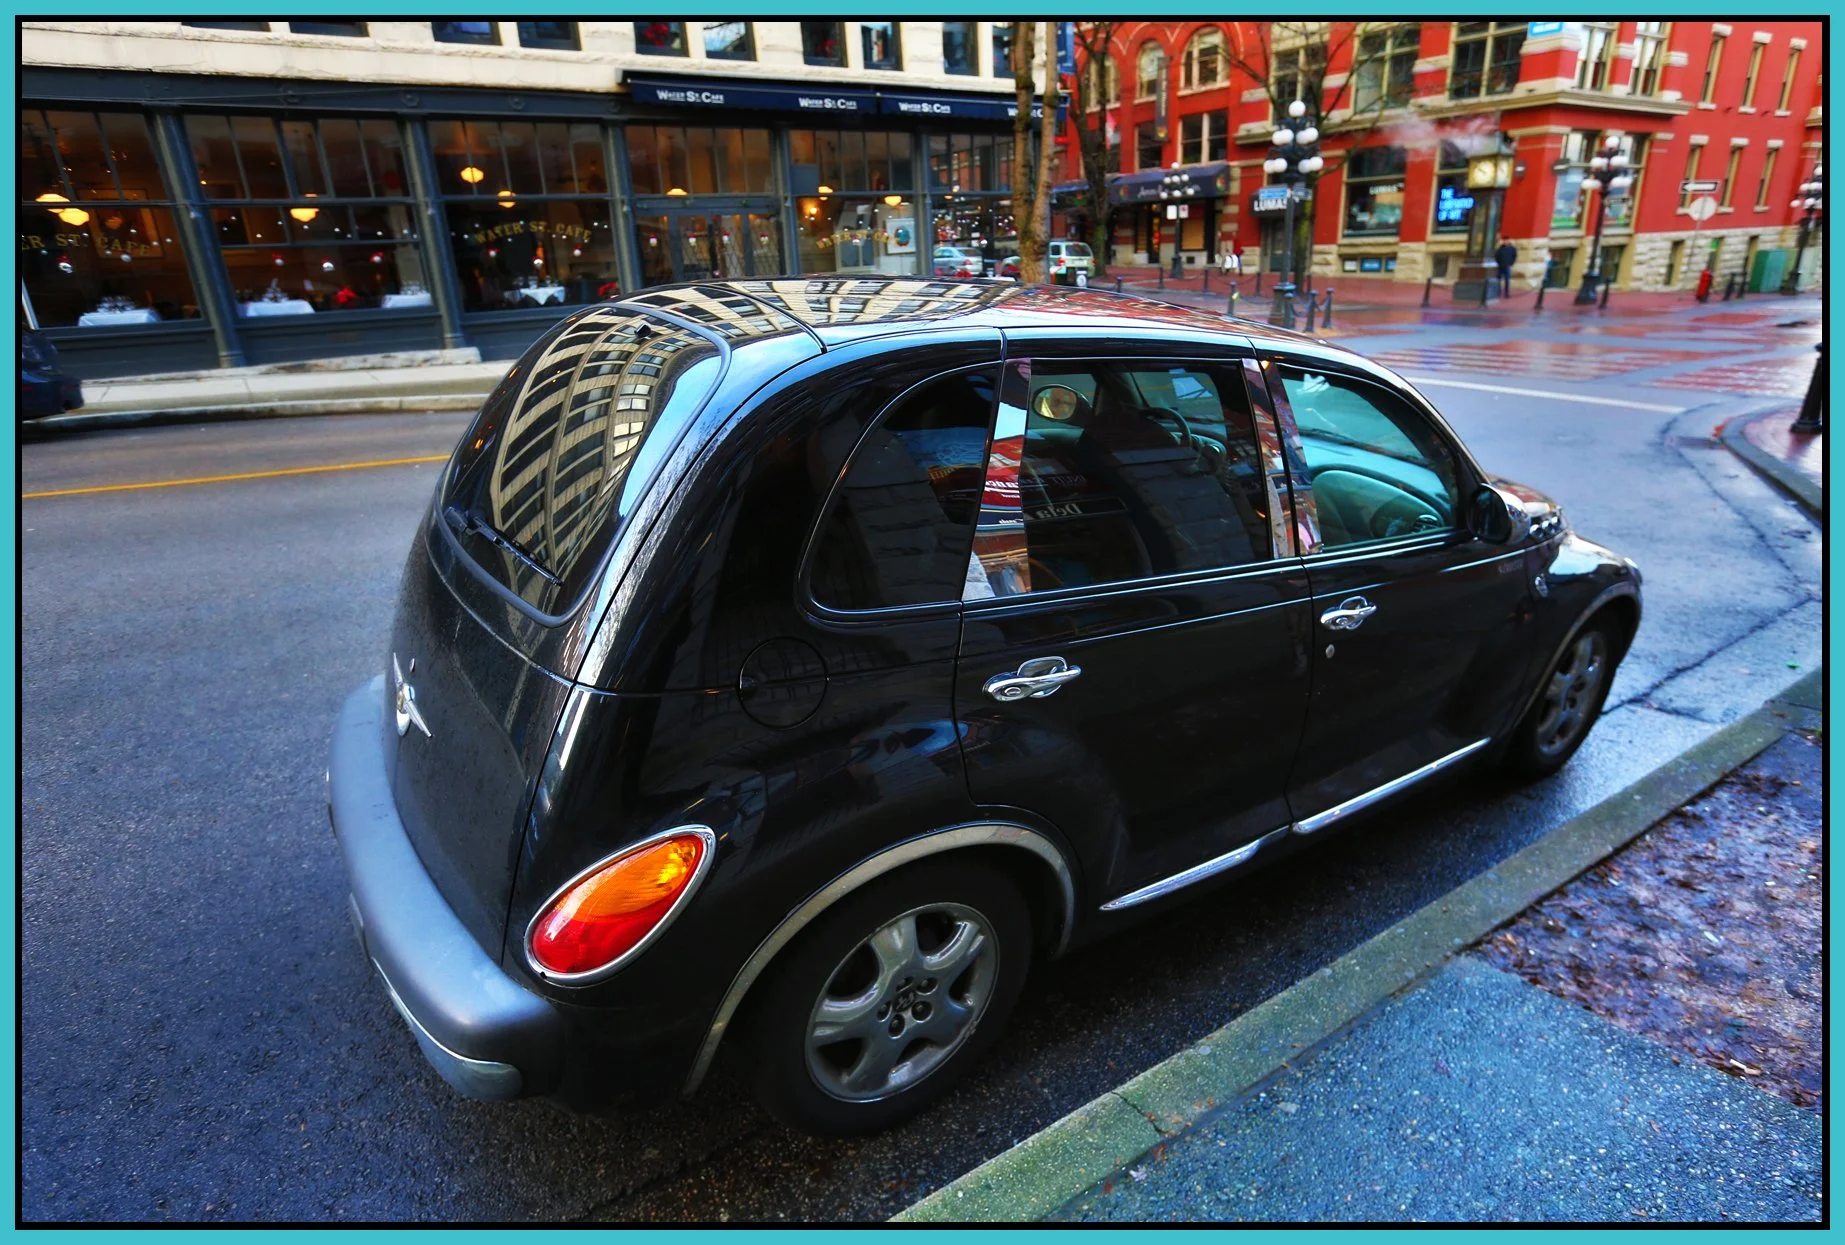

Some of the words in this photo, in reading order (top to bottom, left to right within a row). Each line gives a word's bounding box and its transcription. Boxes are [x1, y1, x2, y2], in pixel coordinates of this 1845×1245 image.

[475, 222, 525, 244] WATER
[556, 223, 593, 241] CAFE
[95, 235, 152, 258] CAFE
